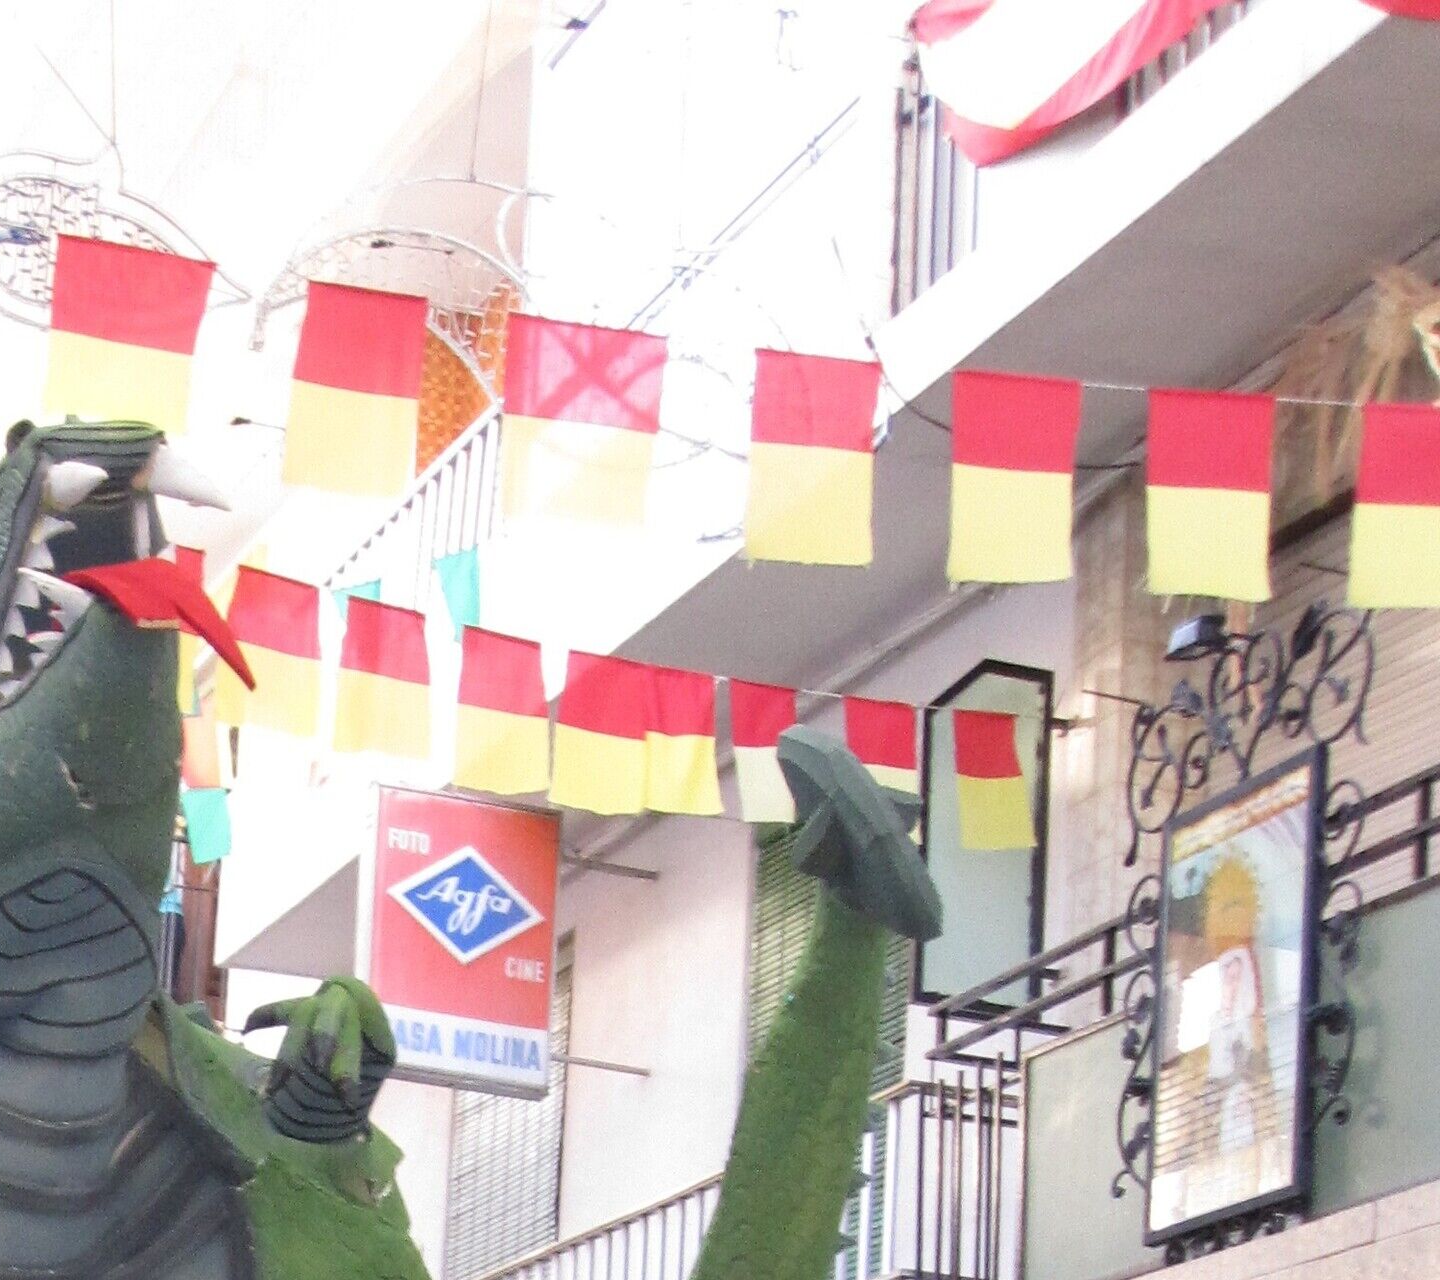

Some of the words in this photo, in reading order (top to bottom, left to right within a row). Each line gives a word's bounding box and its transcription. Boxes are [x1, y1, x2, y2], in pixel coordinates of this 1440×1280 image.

[387, 826, 432, 855] FOTO
[416, 875, 513, 937] Agfa
[503, 957, 546, 984] CINE
[394, 1018, 443, 1056] ASA
[453, 1028, 542, 1071] MOLINA
